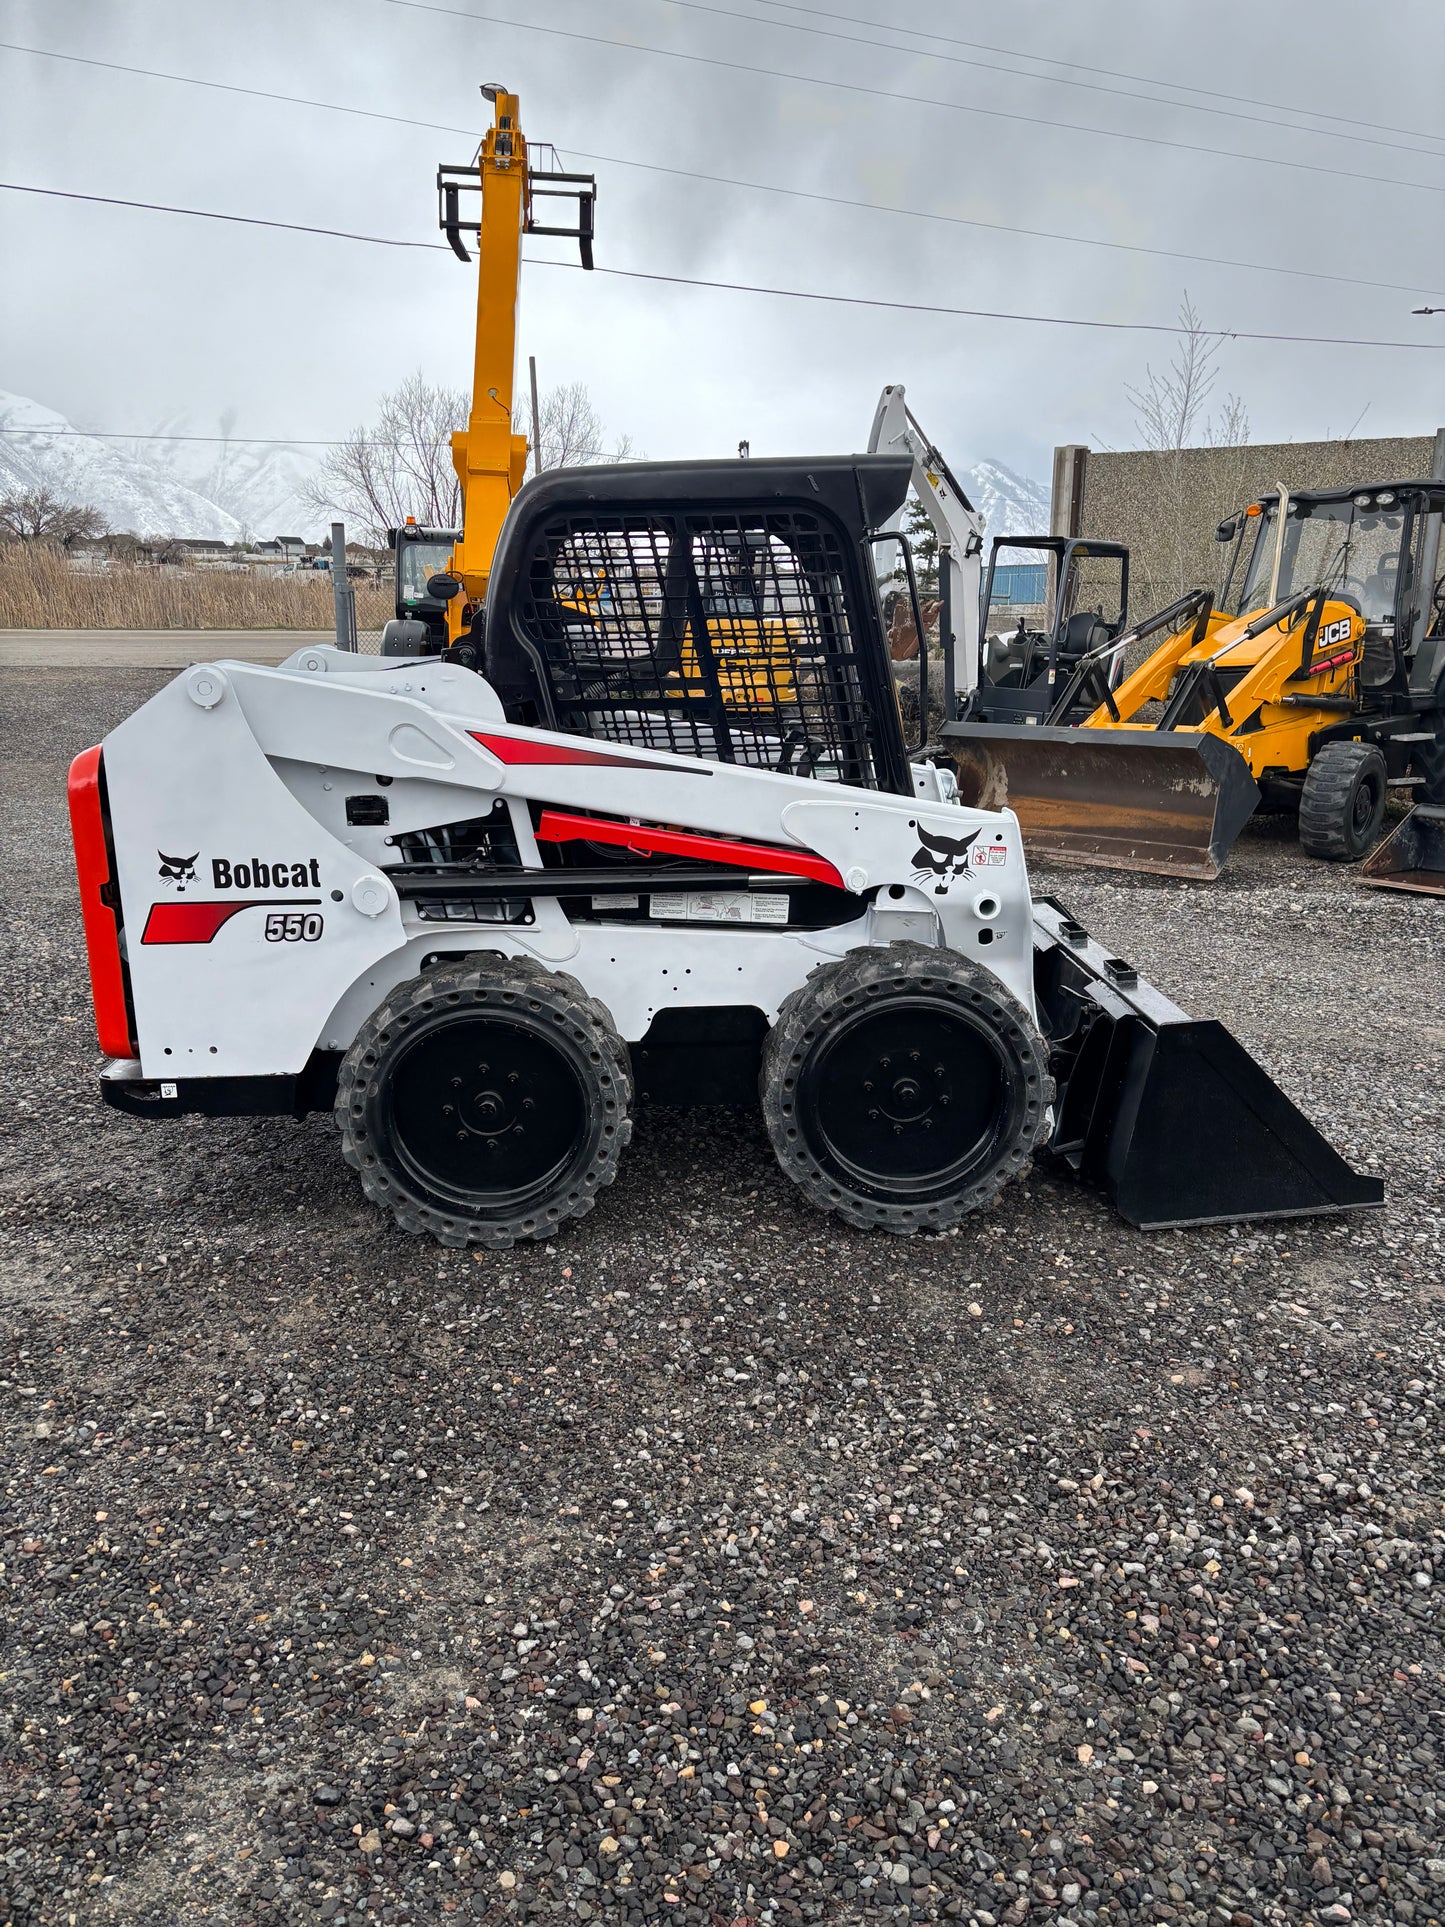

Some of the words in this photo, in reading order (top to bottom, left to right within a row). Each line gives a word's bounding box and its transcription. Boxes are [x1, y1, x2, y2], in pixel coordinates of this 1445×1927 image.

[1319, 619, 1350, 647] JCB
[212, 858, 321, 888] Bobcat
[265, 913, 324, 942] 550
